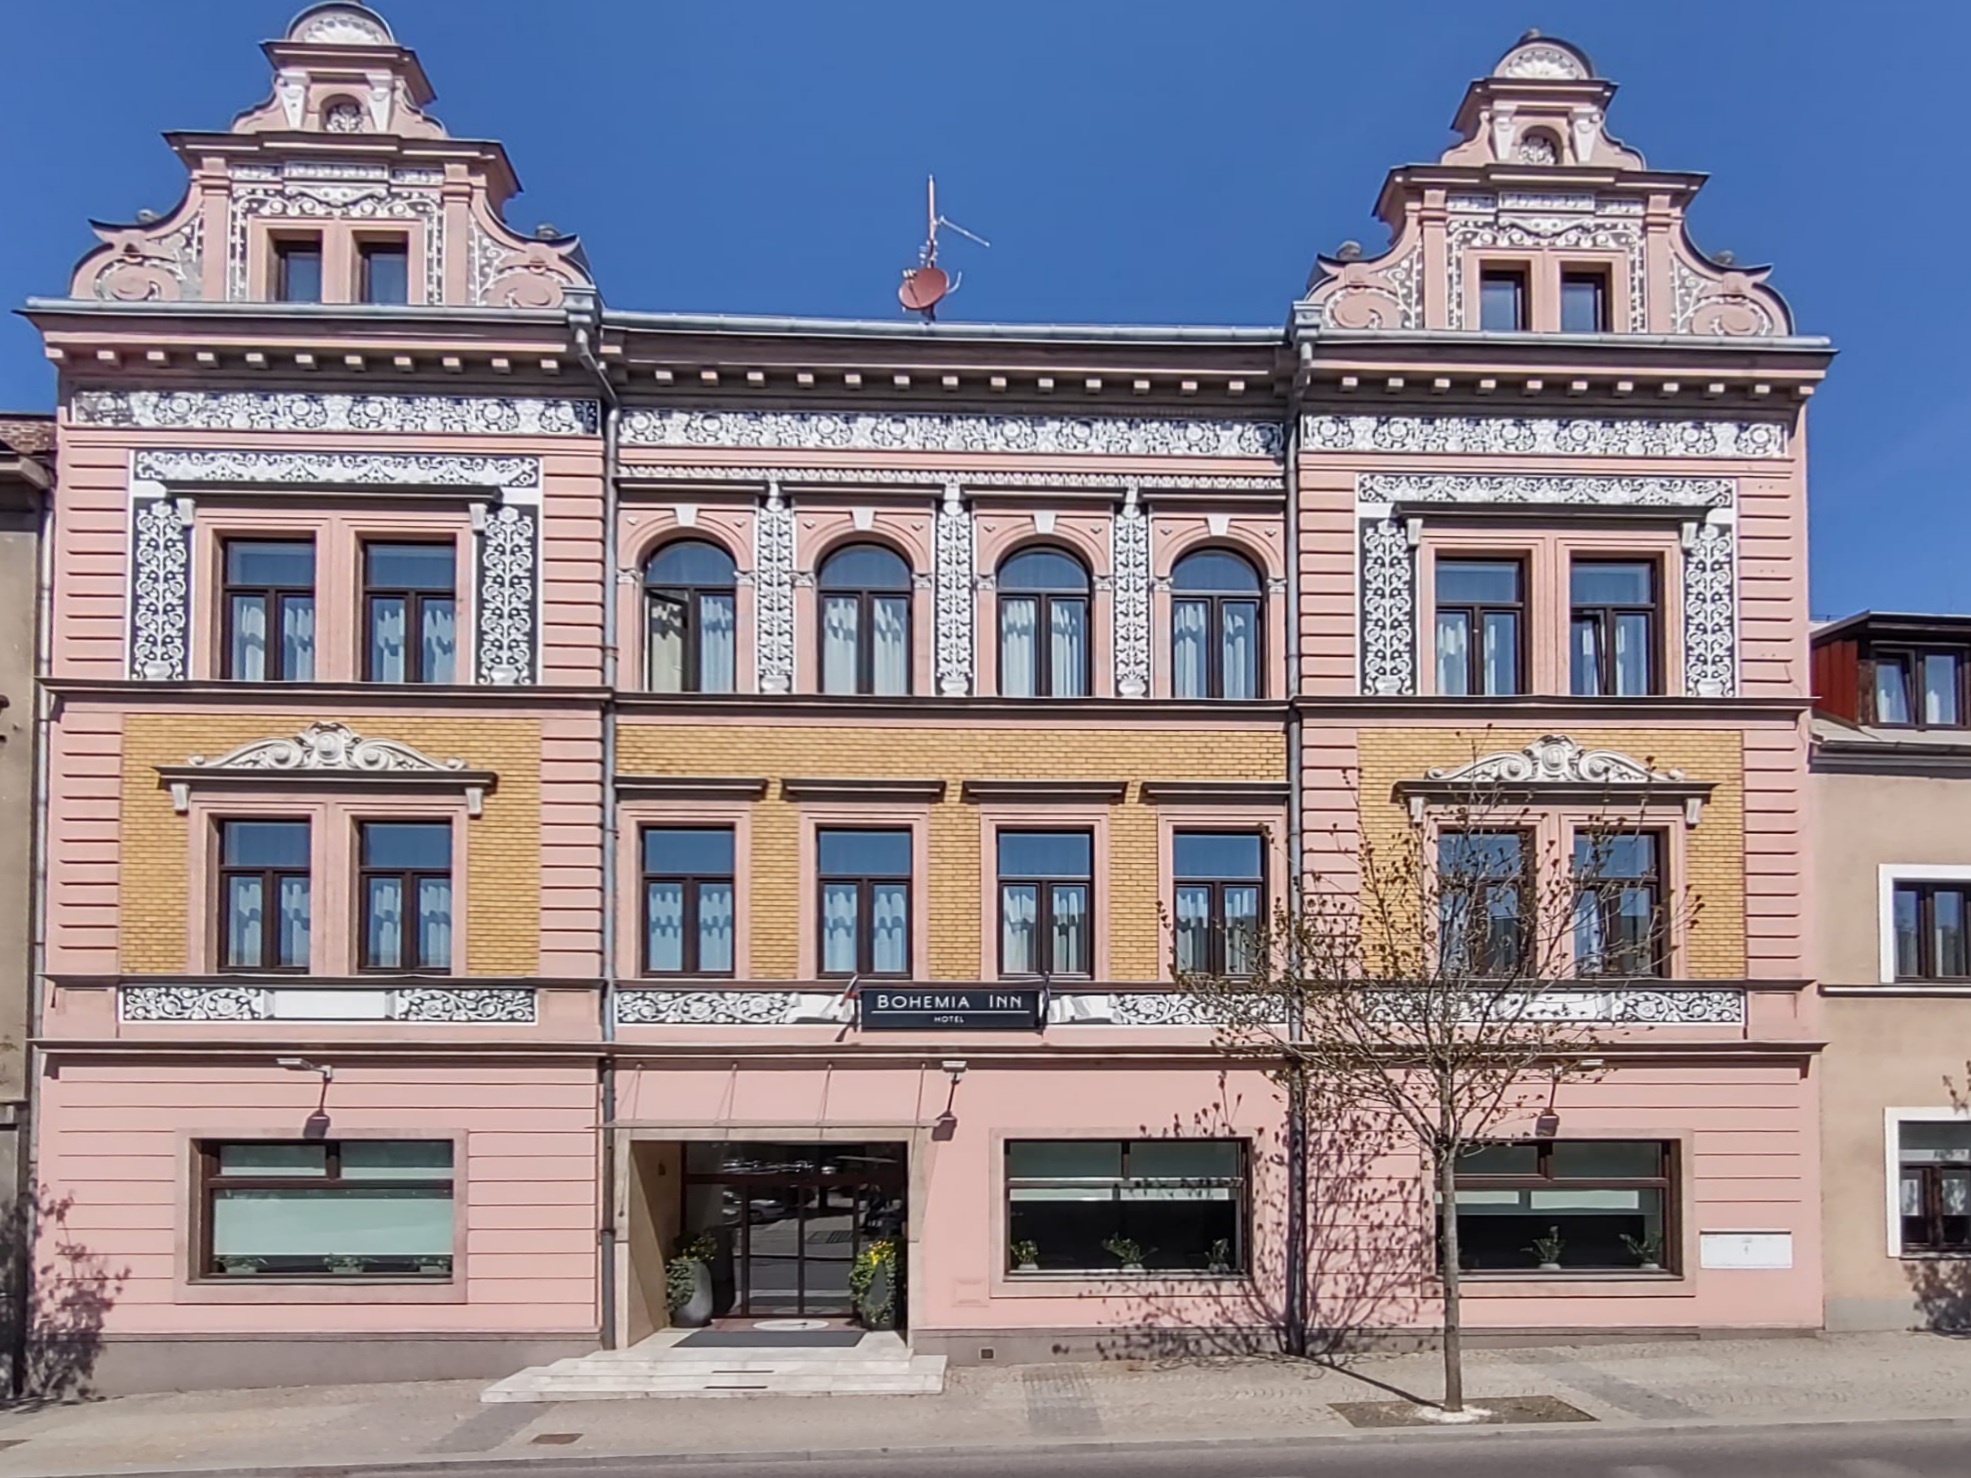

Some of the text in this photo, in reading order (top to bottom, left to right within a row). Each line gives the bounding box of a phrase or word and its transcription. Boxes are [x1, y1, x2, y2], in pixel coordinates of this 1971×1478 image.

[877, 995, 1022, 1008] BOHEMIA INN
[934, 1015, 964, 1023] HOTEL
